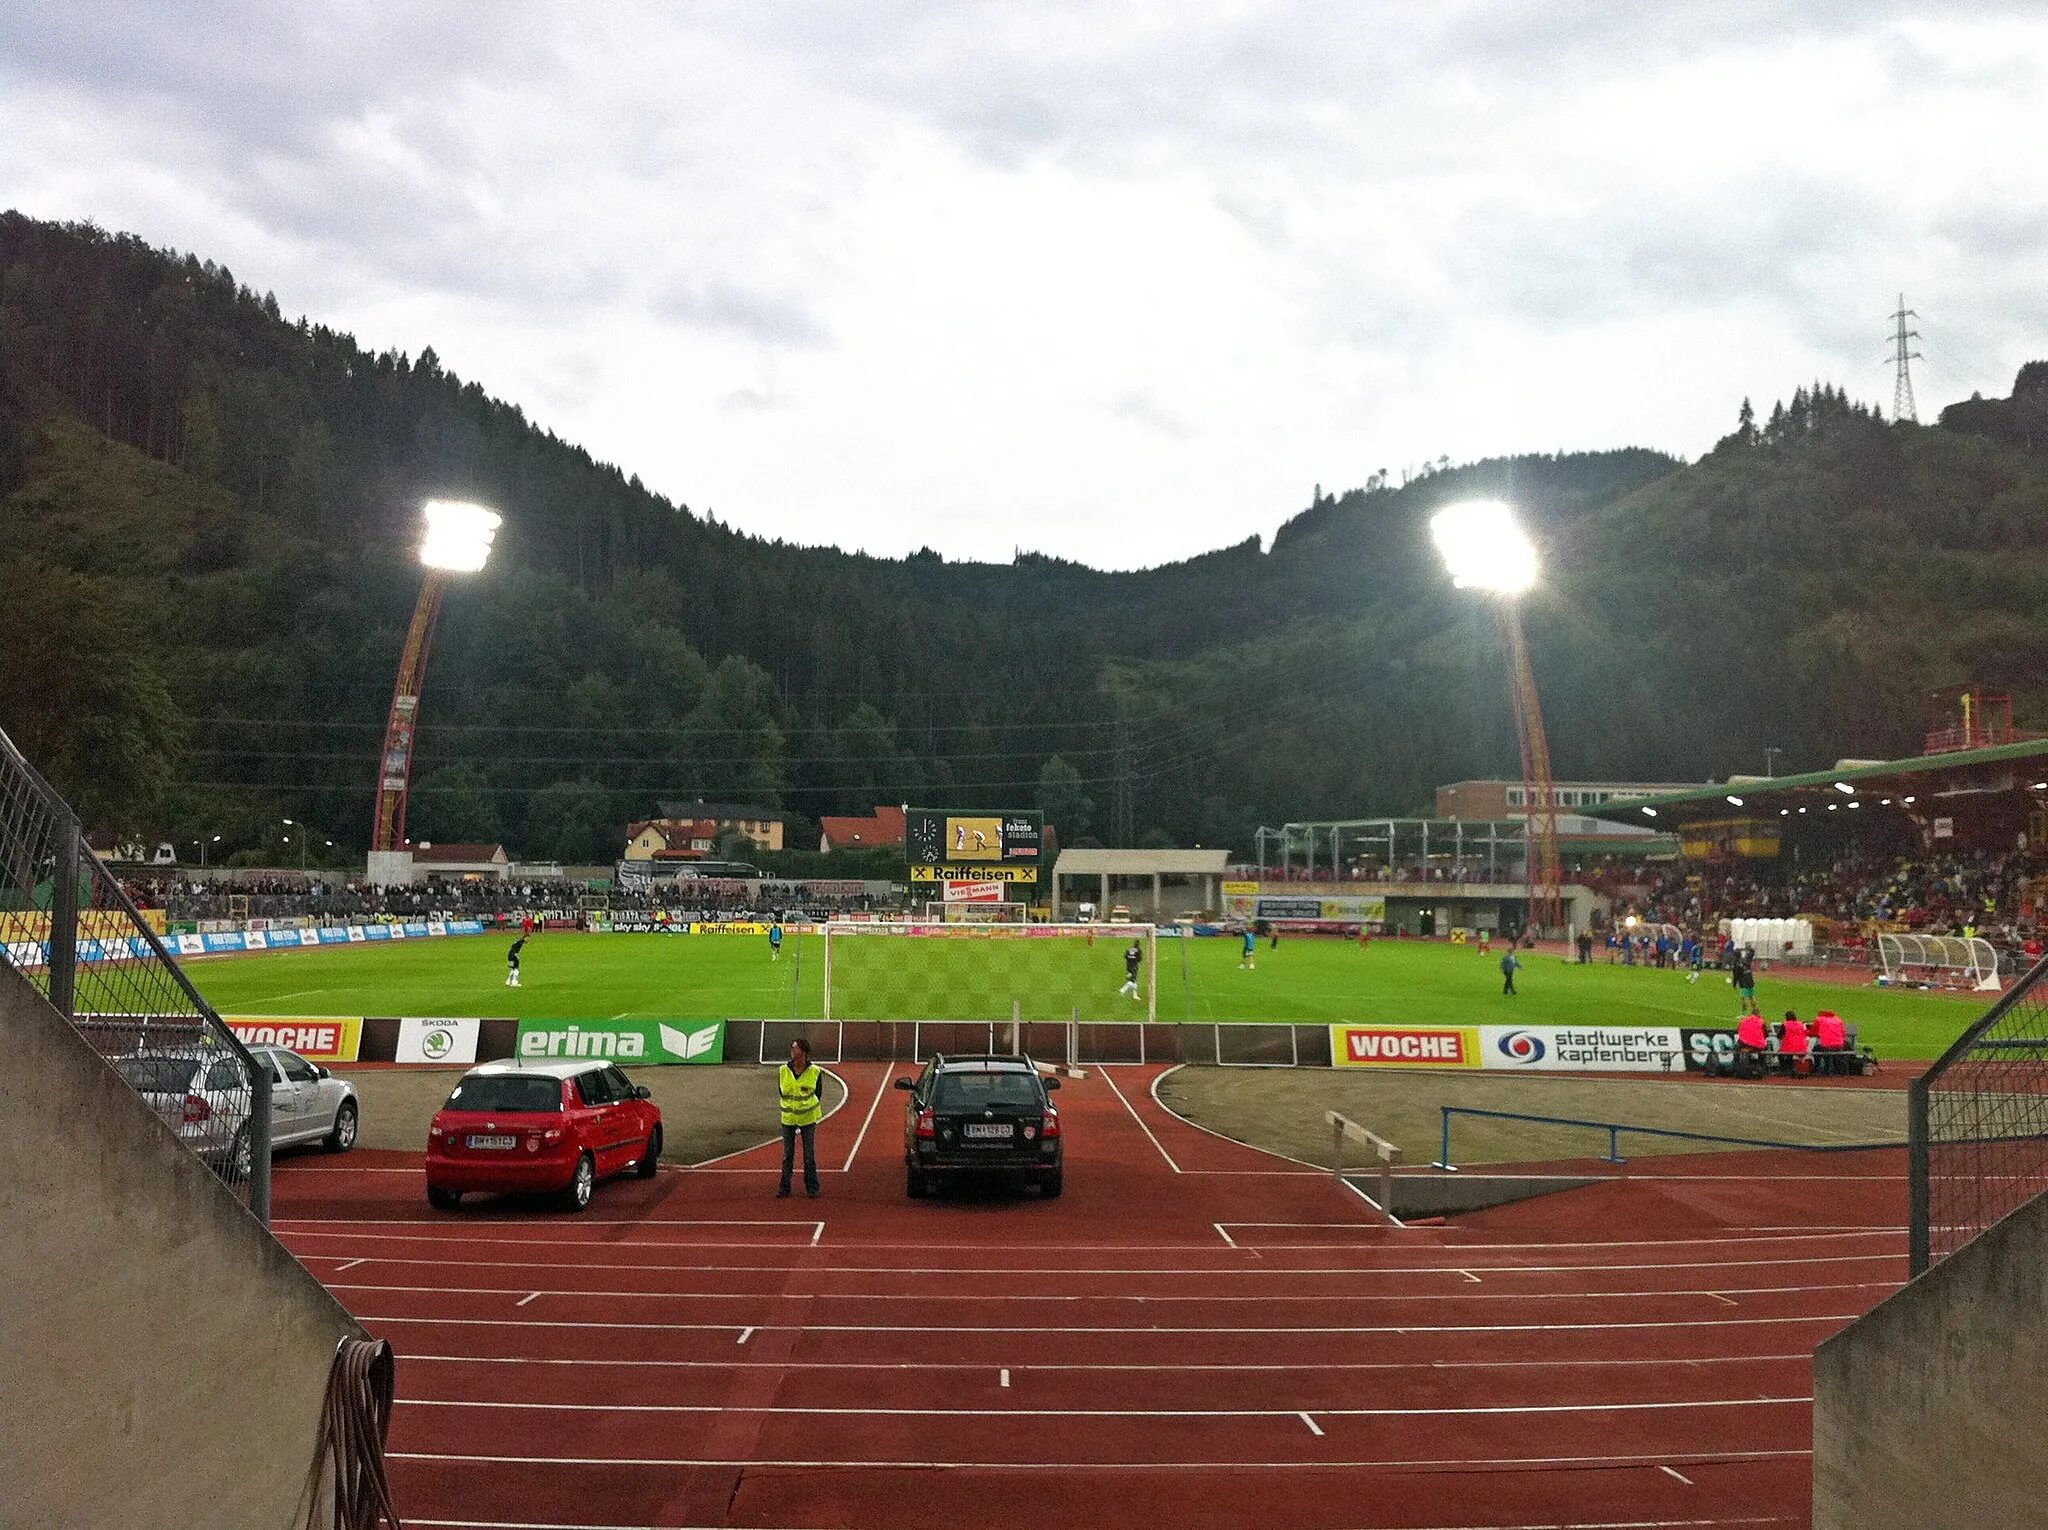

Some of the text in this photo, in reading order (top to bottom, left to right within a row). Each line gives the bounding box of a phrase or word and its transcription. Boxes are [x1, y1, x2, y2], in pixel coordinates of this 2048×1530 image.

[934, 867, 1014, 880] Raiffeisen
[614, 923, 651, 934] sky sky
[700, 924, 755, 934] Raiffeisen
[521, 1026, 645, 1057] erima
[1555, 1031, 1669, 1046] stadtwerke
[1350, 1035, 1459, 1058] WOCHE
